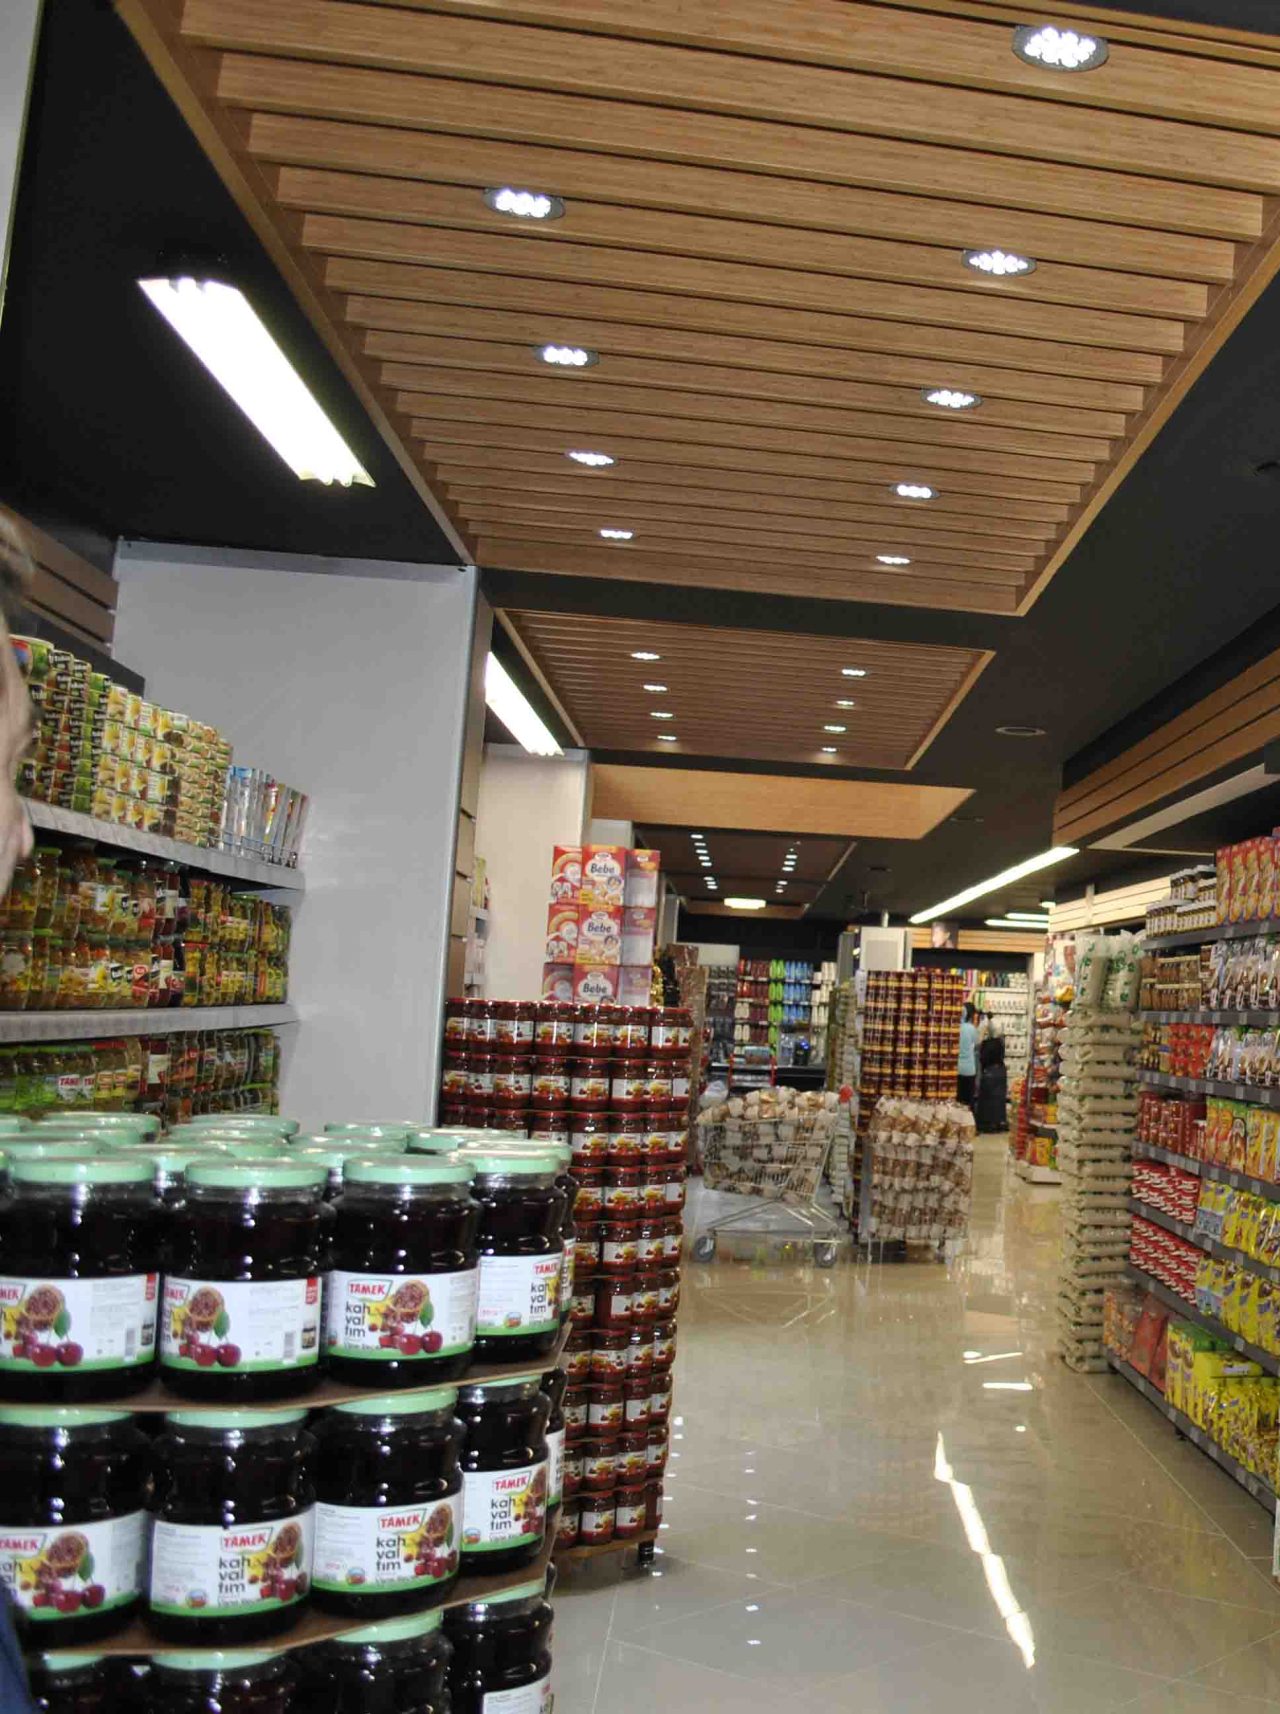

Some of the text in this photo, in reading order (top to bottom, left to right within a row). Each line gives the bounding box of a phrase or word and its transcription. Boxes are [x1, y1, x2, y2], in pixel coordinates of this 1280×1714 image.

[591, 863, 615, 874] Bebe
[588, 923, 612, 934] Bebe
[583, 983, 607, 994] Bebe
[350, 1283, 386, 1295] TAMEK
[345, 1302, 371, 1315] kah
[345, 1314, 365, 1325] val
[496, 1476, 528, 1490] TAMEK
[491, 1496, 517, 1508] kah
[491, 1507, 511, 1519] val
[380, 1513, 421, 1528] TAMEK
[223, 1533, 266, 1548] TAMEK
[376, 1535, 406, 1548] kah
[376, 1547, 400, 1559] val
[219, 1556, 251, 1569] kah
[219, 1568, 244, 1580] val
